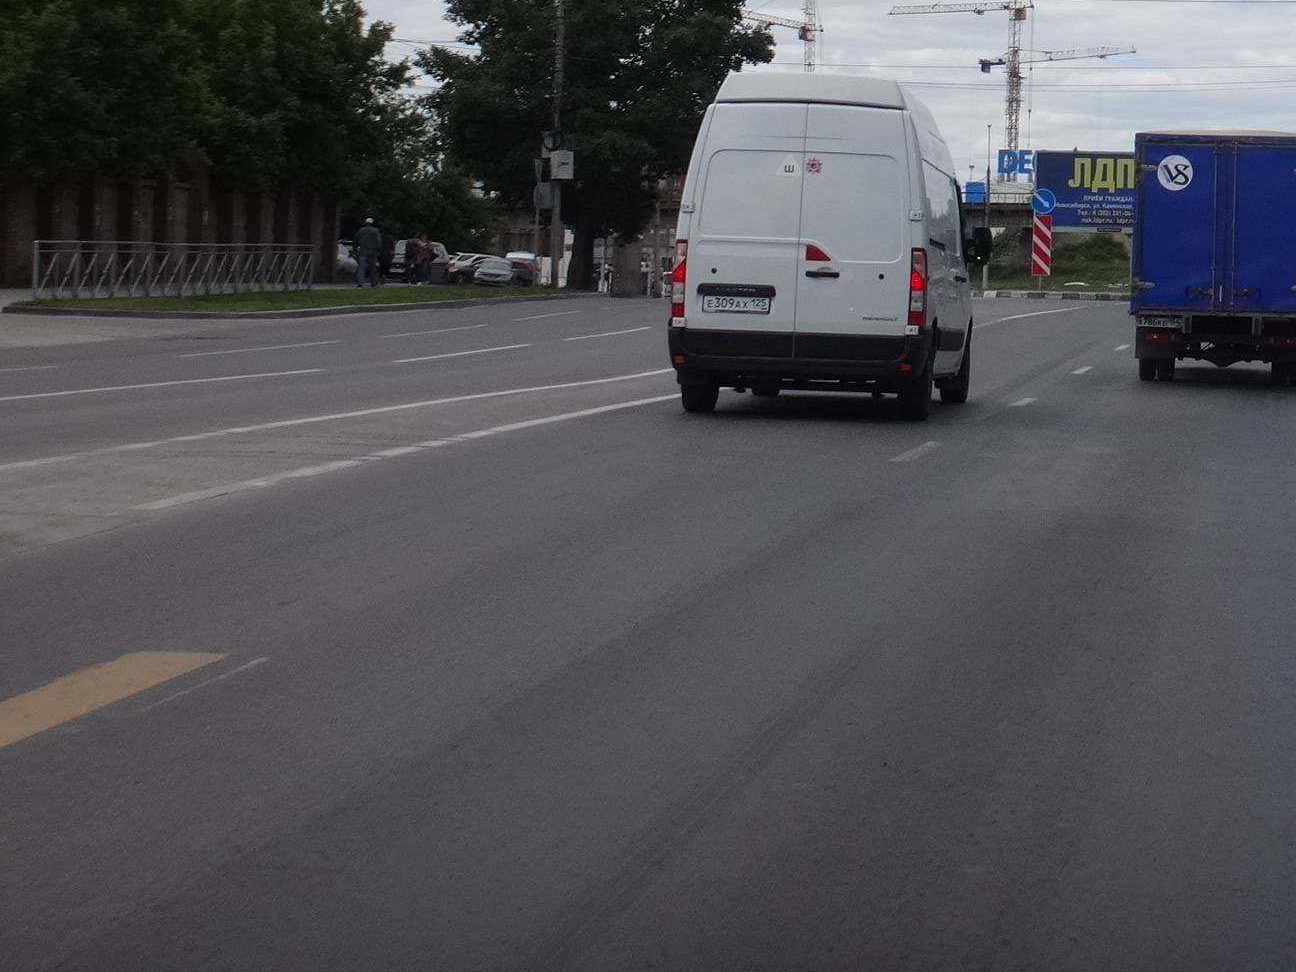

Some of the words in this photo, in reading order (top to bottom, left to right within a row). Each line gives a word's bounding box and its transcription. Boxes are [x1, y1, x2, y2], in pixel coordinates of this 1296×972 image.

[784, 164, 794, 173] Ш
[1068, 158, 1135, 193] ЛДП
[1162, 163, 1190, 185] VS
[750, 298, 767, 308] 125
